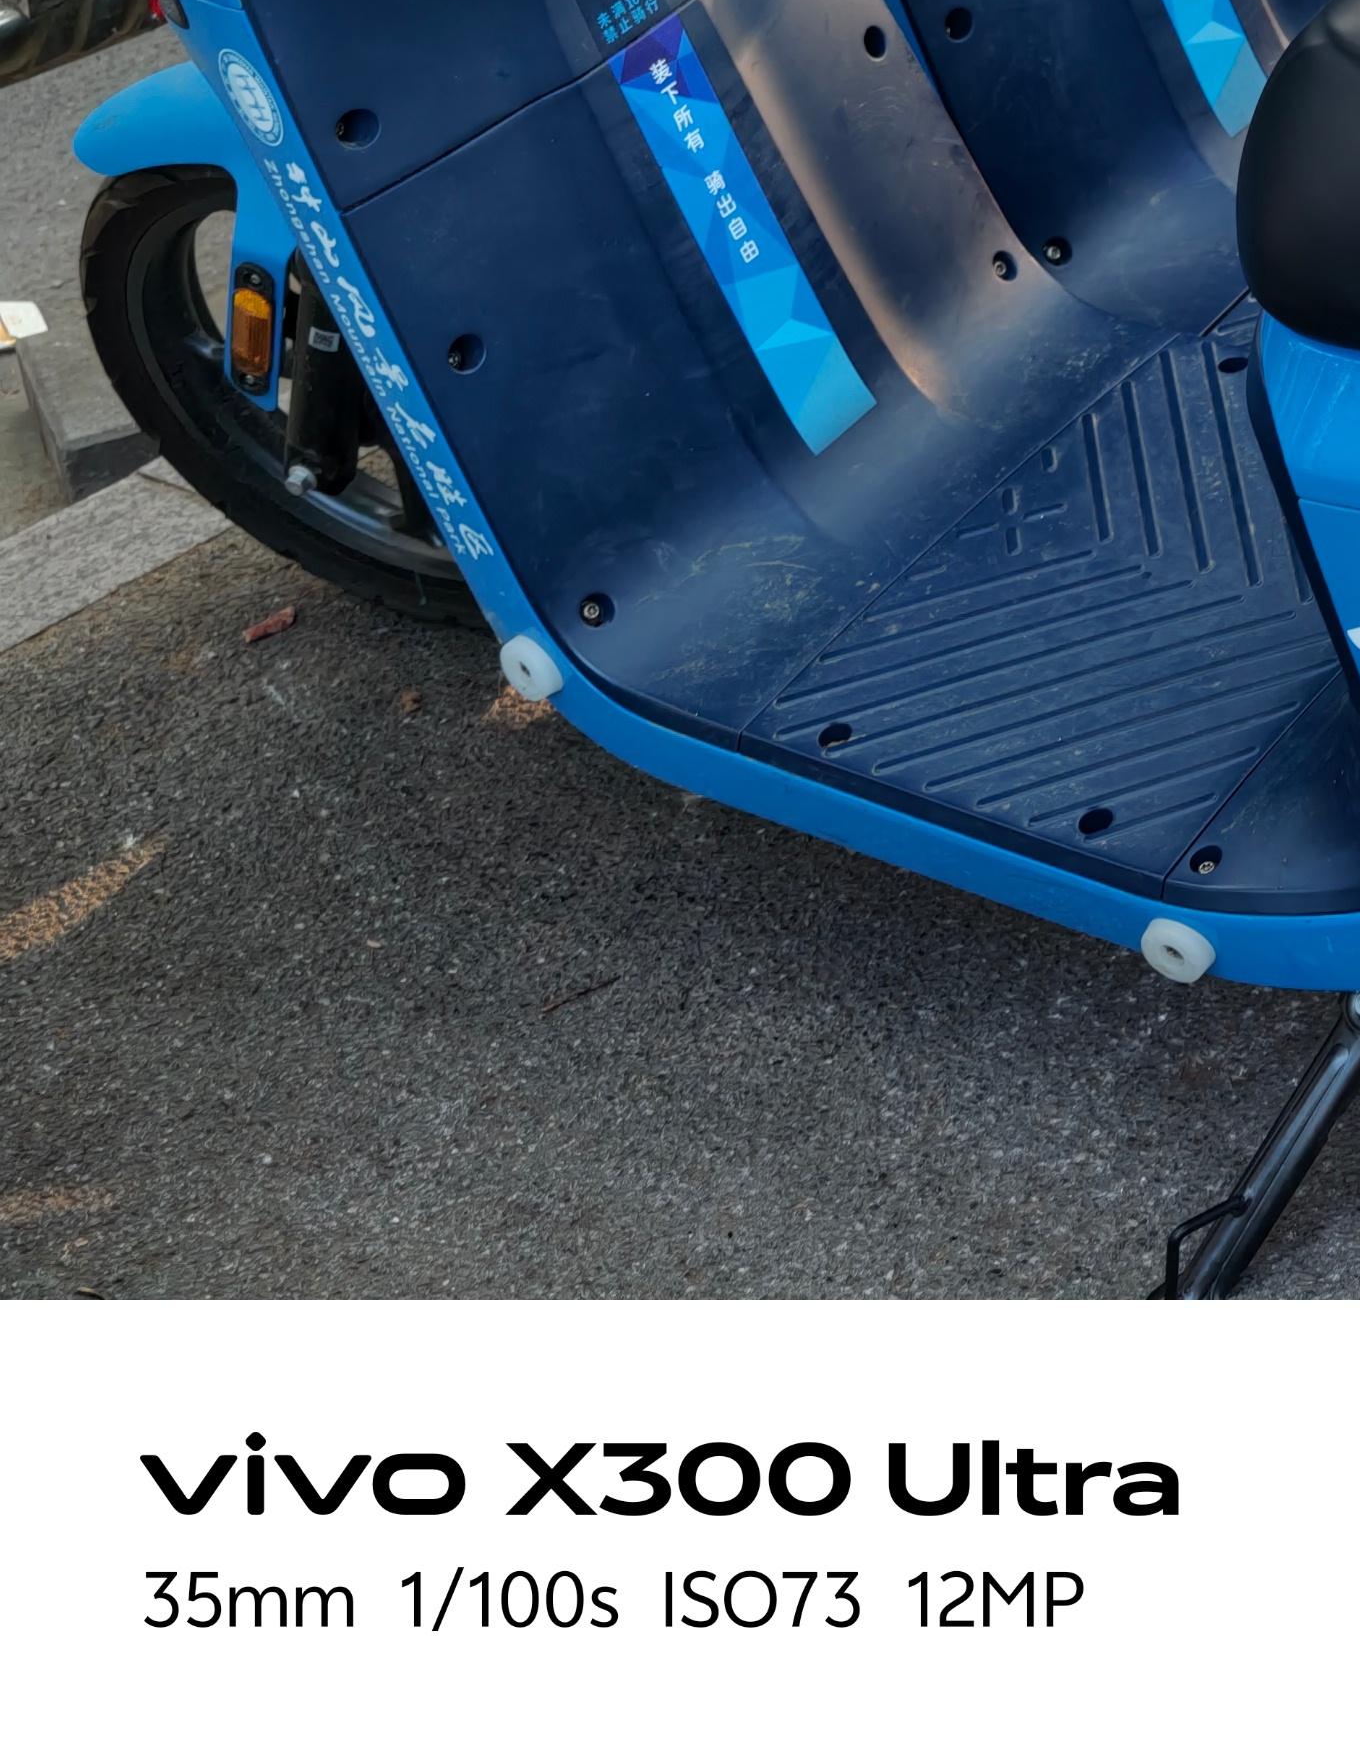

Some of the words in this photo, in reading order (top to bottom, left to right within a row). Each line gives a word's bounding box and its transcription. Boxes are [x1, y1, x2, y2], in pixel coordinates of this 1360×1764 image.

[650, 58, 705, 154] 装下所有
[703, 170, 760, 264] 骑出自由
[264, 158, 332, 285] Zhongshan
[329, 293, 388, 398] Mountain
[386, 405, 439, 510] National
[434, 506, 467, 555] Park
